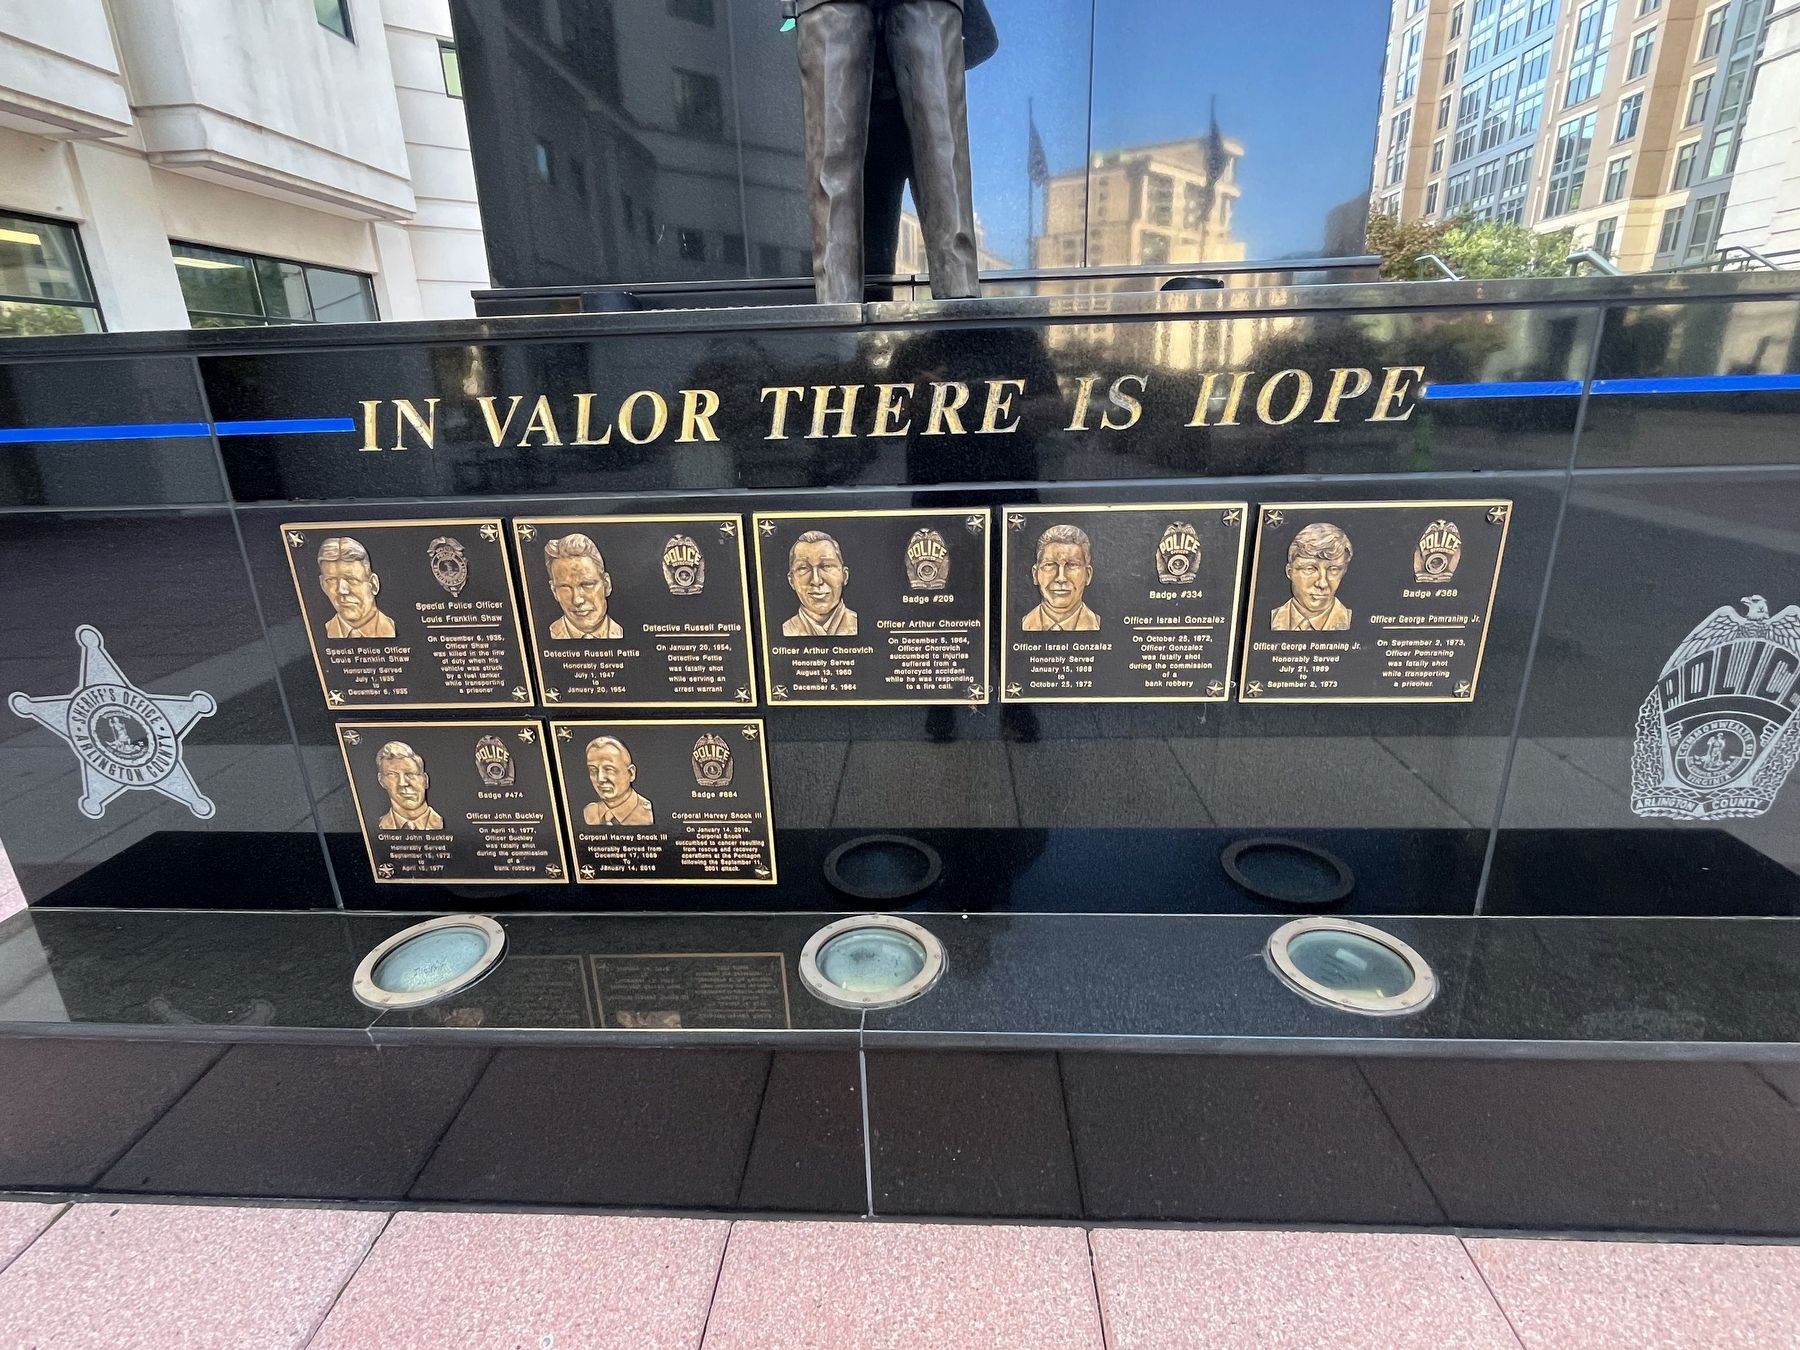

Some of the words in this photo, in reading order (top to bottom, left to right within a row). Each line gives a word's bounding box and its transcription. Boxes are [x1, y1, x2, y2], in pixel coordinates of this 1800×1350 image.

[358, 398, 441, 451] IN
[476, 389, 721, 448] VALOR
[760, 379, 1026, 440] THERE
[1063, 374, 1149, 431] IS
[1184, 366, 1425, 427] HOPE
[1159, 533, 1200, 554] POLICE
[1419, 531, 1462, 551] POLICE
[907, 540, 947, 560] POLICE
[664, 545, 702, 566] POLICE
[1149, 590, 1177, 600] Badge
[1180, 590, 1202, 598] #334
[1402, 589, 1431, 599] Badge
[902, 595, 929, 604] Badge
[932, 594, 954, 602] #209
[415, 601, 445, 611] Special
[447, 601, 472, 609] Police
[475, 600, 502, 609] Officer
[421, 615, 442, 623] Louis
[445, 614, 477, 622] Franklin
[480, 614, 502, 622] Shaw
[1123, 616, 1153, 624] Officer
[1156, 616, 1180, 624] Israel
[1184, 615, 1225, 623] Gonzalez
[1370, 615, 1396, 623] Officer
[1398, 614, 1425, 624] George
[1428, 614, 1468, 624] Pomraning
[1471, 614, 1480, 622] Jr.
[642, 623, 680, 632] Detective
[684, 623, 713, 631] Russell
[876, 620, 905, 628] Officer
[908, 619, 935, 627] Arthur
[938, 619, 980, 627] Chorovich
[1012, 643, 1041, 651] Officer
[1072, 642, 1112, 650] Gonzalez
[1168, 643, 1203, 651] Gonzalez
[1253, 642, 1278, 650] Officer
[1280, 642, 1306, 651] George
[1309, 642, 1349, 651] Pomraning
[1391, 639, 1432, 647] September
[325, 647, 354, 656] Special
[383, 646, 410, 654] Officer
[669, 644, 696, 652] January
[771, 646, 799, 654] Officer
[803, 646, 829, 654] Arthur
[832, 646, 873, 654] Chorovich
[543, 649, 580, 657] Detective
[584, 649, 613, 657] Russell
[1159, 653, 1181, 661] fatally
[1414, 649, 1454, 657] Pomraning
[354, 655, 385, 663] Franklin
[791, 659, 827, 667] Honorably
[829, 658, 854, 666] Served
[1029, 656, 1066, 664] Honorably
[1272, 655, 1310, 663] Honorably
[562, 662, 597, 670] Honorably
[1128, 662, 1152, 670] during
[1169, 661, 1212, 669] commission
[1405, 660, 1428, 668] fatally
[795, 669, 820, 677] August
[1278, 665, 1295, 673] July
[1161, 670, 1170, 678] of
[1404, 670, 1450, 678] transporting
[1267, 680, 1307, 688] September
[1401, 680, 1433, 688] prisoner.
[567, 686, 594, 694] January
[72, 688, 116, 724] SHERIFF'S
[123, 691, 162, 725] OFFICE
[1679, 721, 1753, 756] COMMONWEALTH
[76, 734, 145, 782] ARLINGTON
[146, 734, 171, 778] COUNTY
[475, 745, 509, 762] POLICE
[693, 745, 730, 762] POLICE
[1687, 774, 1731, 785] VIRGINIA
[477, 791, 501, 799] Badge
[691, 790, 715, 799] Badge
[1635, 798, 1696, 811] ARLINGTON
[1712, 799, 1762, 810] COUNTY
[514, 812, 543, 820] Buckley
[671, 811, 701, 820] Corporal
[703, 812, 727, 820] Harvey
[730, 811, 752, 819] Snook
[425, 834, 453, 842] Buckley
[578, 833, 608, 841] Corporal
